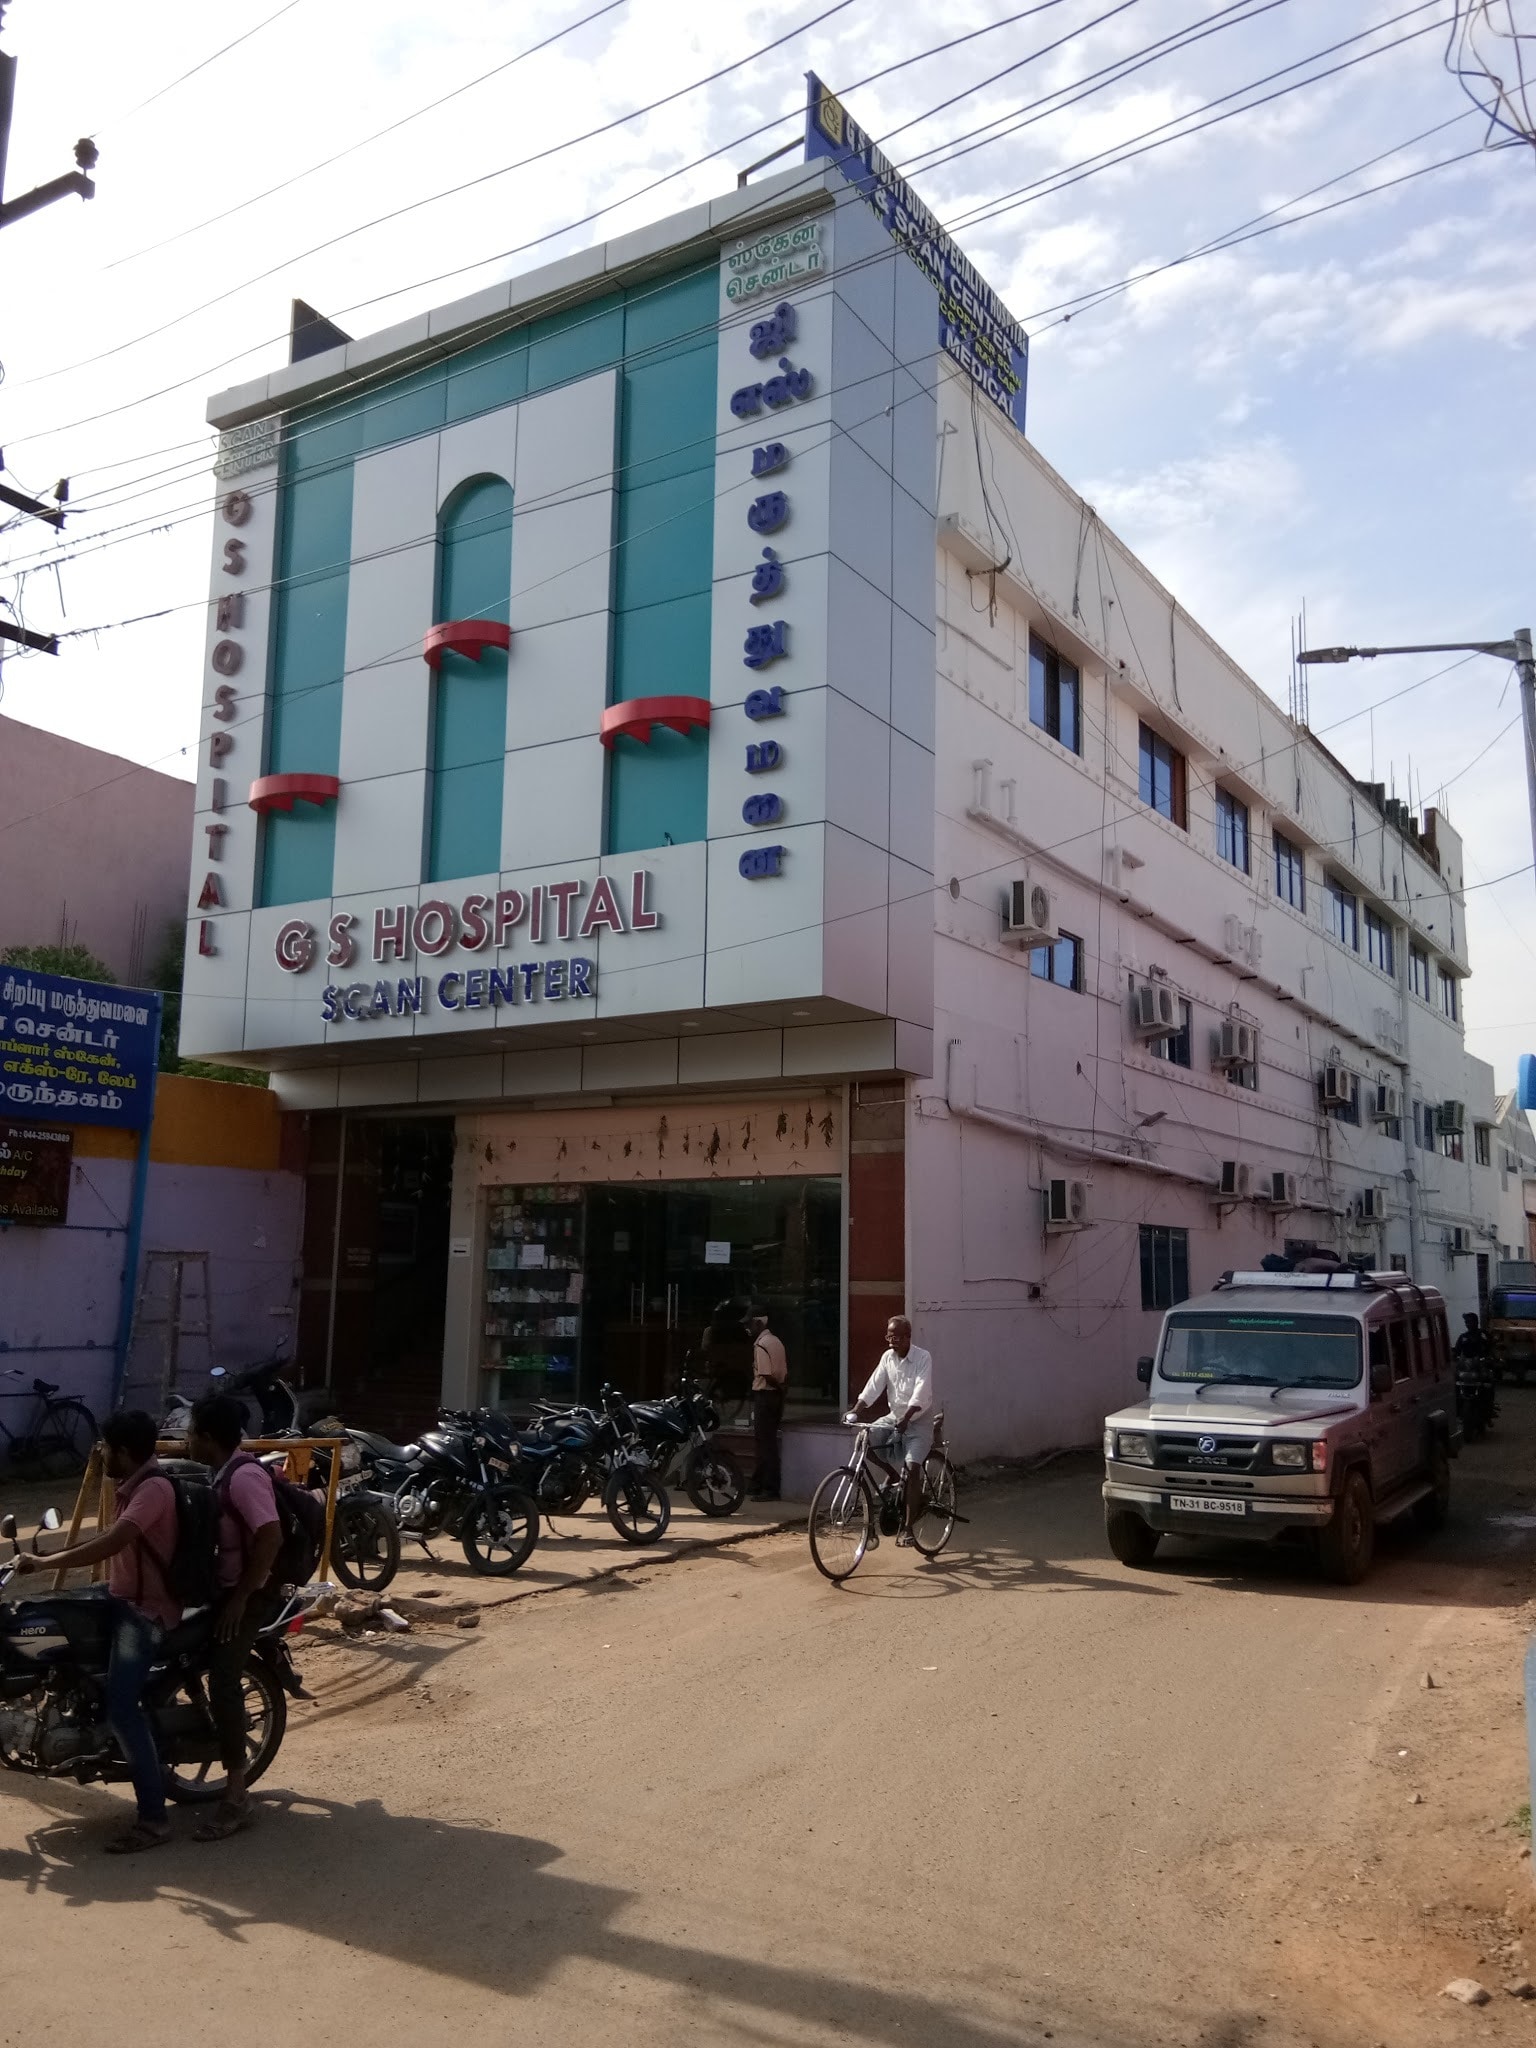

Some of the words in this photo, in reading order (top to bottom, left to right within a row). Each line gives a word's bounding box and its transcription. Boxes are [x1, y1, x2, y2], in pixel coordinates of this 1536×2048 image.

[871, 145, 906, 204] MULTI
[906, 186, 938, 245] SUPER
[938, 234, 990, 307] SPECIALITY
[990, 293, 1027, 357] HOSPITAL
[895, 206, 946, 284] SCAN
[950, 274, 1013, 364] CENTER
[949, 295, 996, 355] DOPPLER
[997, 354, 1022, 389] SCAN
[946, 329, 1018, 424] MEDICAL
[214, 441, 275, 478] CENTER
[221, 421, 268, 449] SCAN
[274, 918, 314, 973] G
[325, 912, 358, 968] S
[372, 869, 661, 962] HOSPITAL
[321, 975, 425, 1022] SCAN
[437, 957, 596, 1013] CENTER
[0, 1080, 123, 1110] ருந்தகம்
[12, 1203, 59, 1217] Available
[1173, 1498, 1200, 1510] TN-31
[1203, 1501, 1243, 1513] BC-9518
[20, 1626, 46, 1636] Hero
